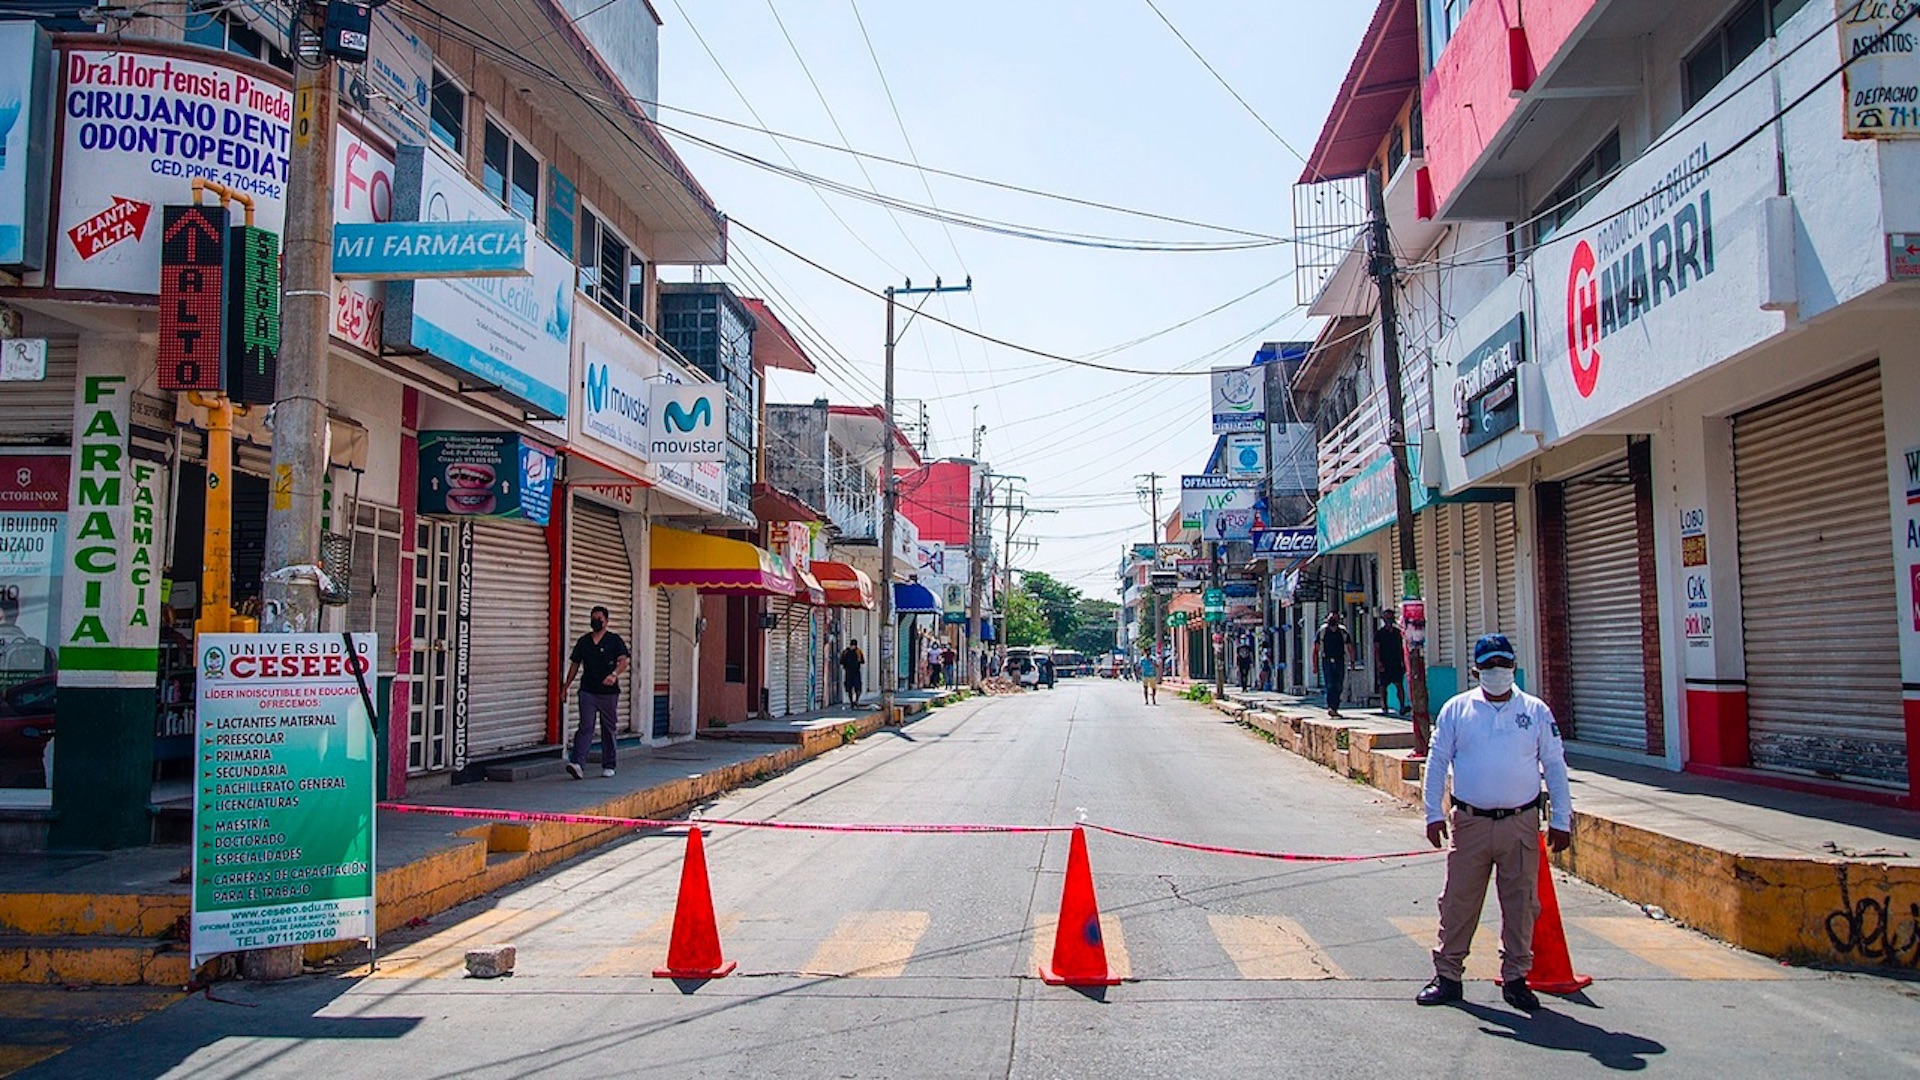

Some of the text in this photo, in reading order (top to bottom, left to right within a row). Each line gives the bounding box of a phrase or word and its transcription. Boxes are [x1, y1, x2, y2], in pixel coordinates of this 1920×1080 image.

[1852, 33, 1919, 57] ASUNTOS:
[235, 75, 291, 123] Pineda
[1855, 86, 1918, 107] DESPACHO
[68, 90, 216, 131] CIRUJANO
[1597, 142, 1710, 263] PRODUCTOS DE BELLEZA
[76, 200, 138, 243] PLANTA
[91, 220, 137, 255] ALTA
[336, 233, 523, 258] MI FARMACIA
[256, 231, 270, 339] SIGA
[176, 268, 203, 385] ALTO
[337, 286, 383, 351] 25%
[611, 386, 650, 429] movistar
[651, 439, 723, 455] movistar
[0, 491, 58, 501] CTORINOX
[70, 376, 126, 643] FARMACIA
[129, 465, 155, 627] FARMACIA
[229, 655, 370, 679] CESEEO
[204, 686, 372, 699] LÍDER INDISCUTIBLE EN EDUCACIN
[259, 699, 322, 709] OFRECEMOS:
[217, 714, 337, 729] LACTANTES MATERNAL
[216, 732, 285, 745] PREESCOLAR
[216, 749, 272, 762] PRIMARIA
[215, 765, 288, 778] SECUNDARIA
[216, 777, 346, 795] BACHILLERATO GENERAL
[215, 796, 299, 811] LICENCIATURAS
[215, 817, 270, 832] MAESTRÍA
[215, 833, 286, 848] DOCTORADO
[215, 849, 302, 865] ESPECIALIDADES
[214, 860, 368, 886] CARRERAS DE CAPACITACIÓN
[213, 884, 311, 903] PARA EL TRABAJO
[231, 902, 340, 921] www.ceseeo.edu.mx
[232, 919, 270, 929] CENTRALES
[308, 913, 327, 921] MAYO
[236, 927, 337, 947] TEL. 9711209160
